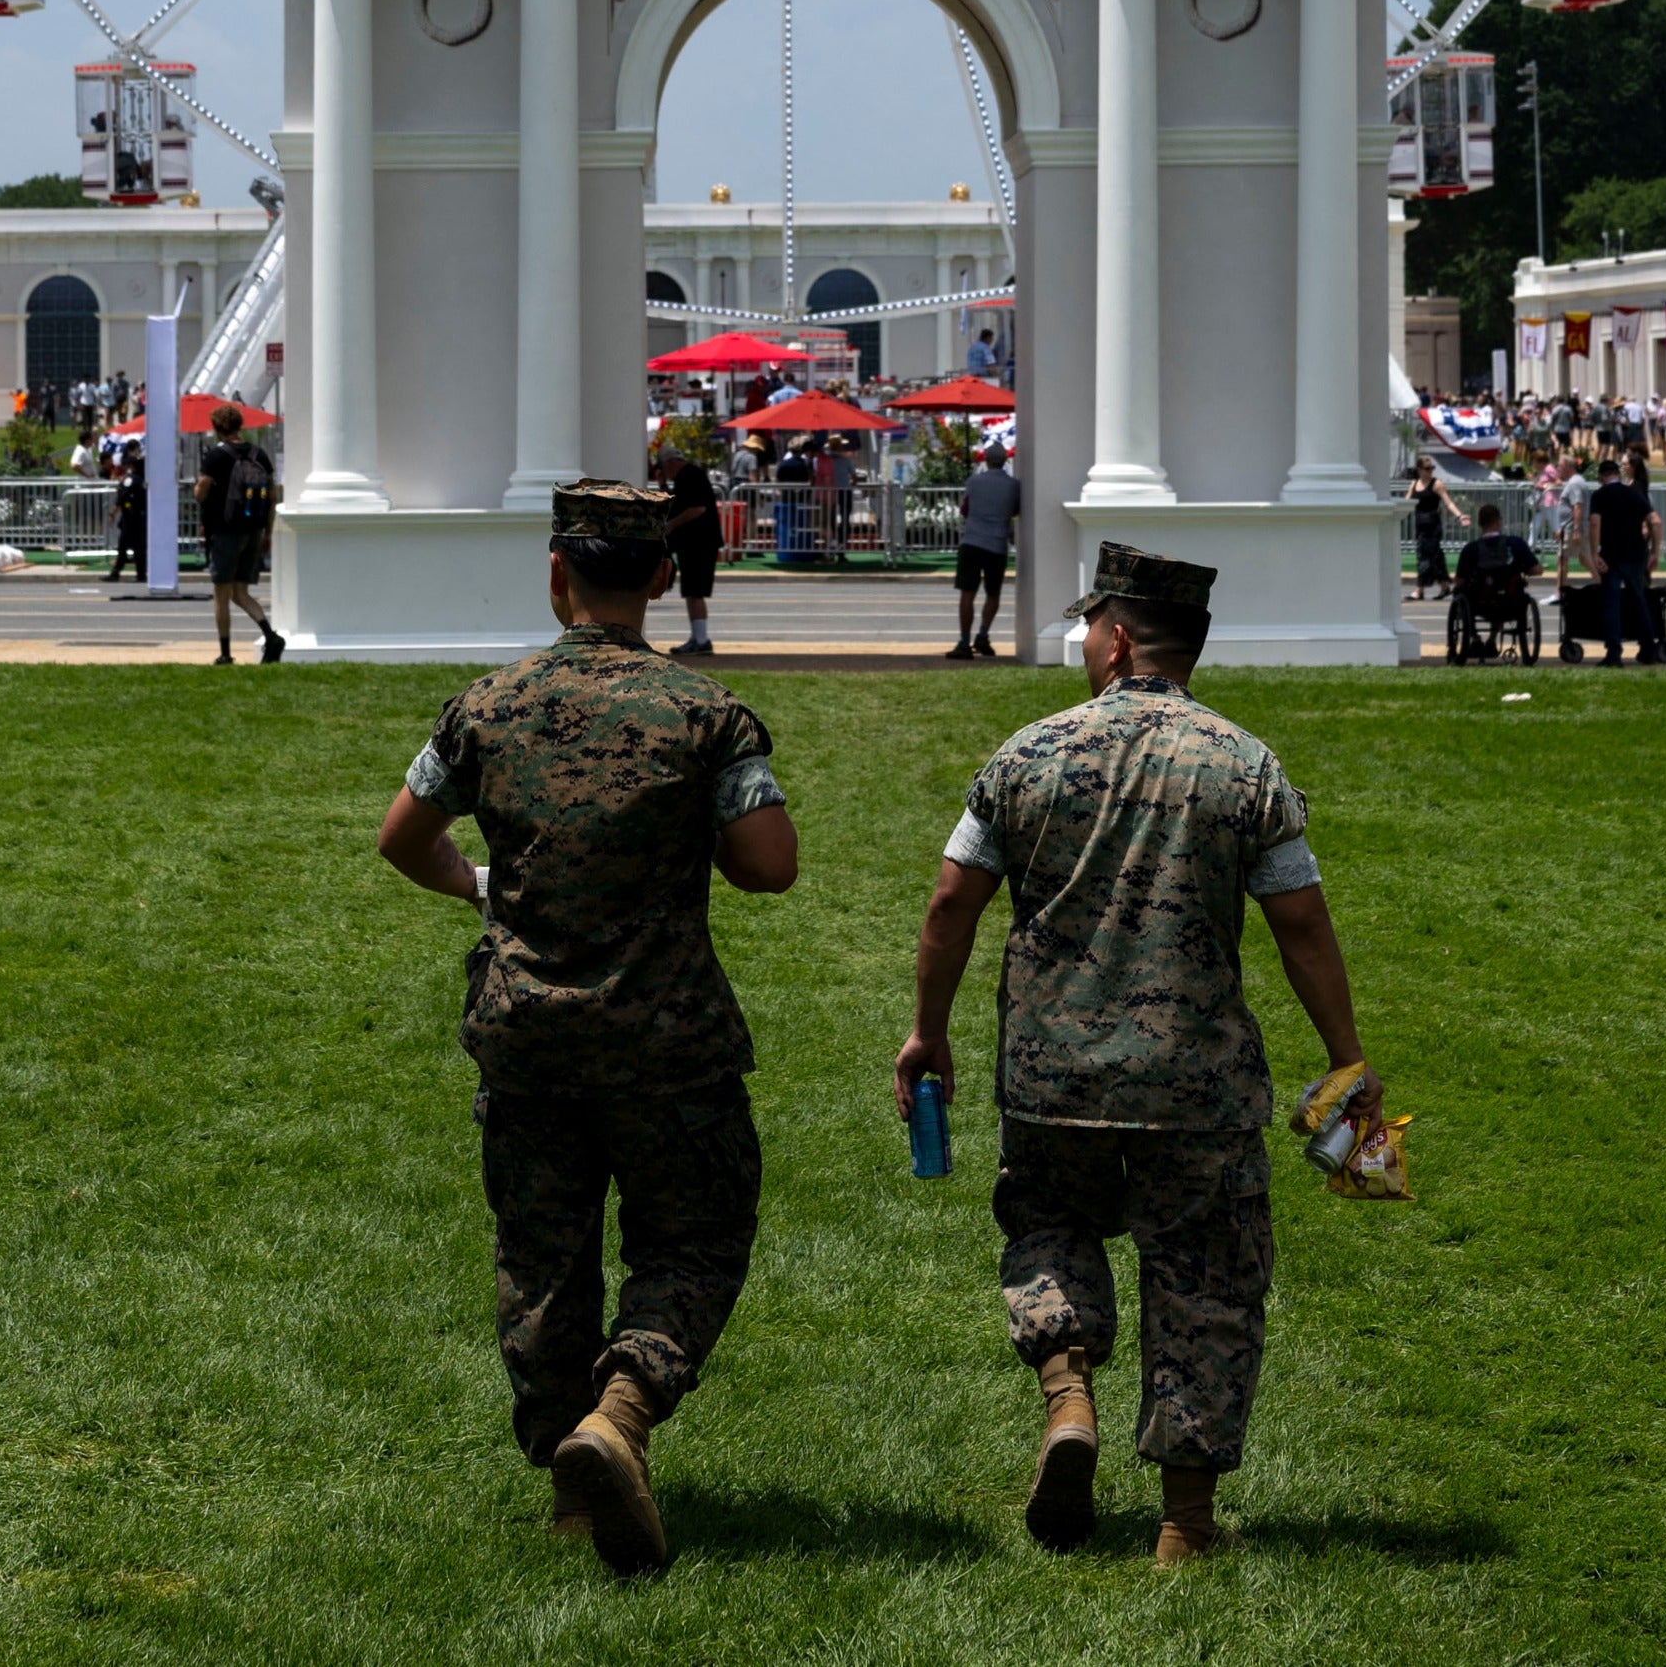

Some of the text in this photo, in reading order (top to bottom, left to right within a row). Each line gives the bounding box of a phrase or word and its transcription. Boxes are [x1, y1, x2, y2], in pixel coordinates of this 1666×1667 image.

[1567, 333, 1586, 350] GA
[1617, 325, 1631, 343] AL
[1526, 335, 1540, 353] FL
